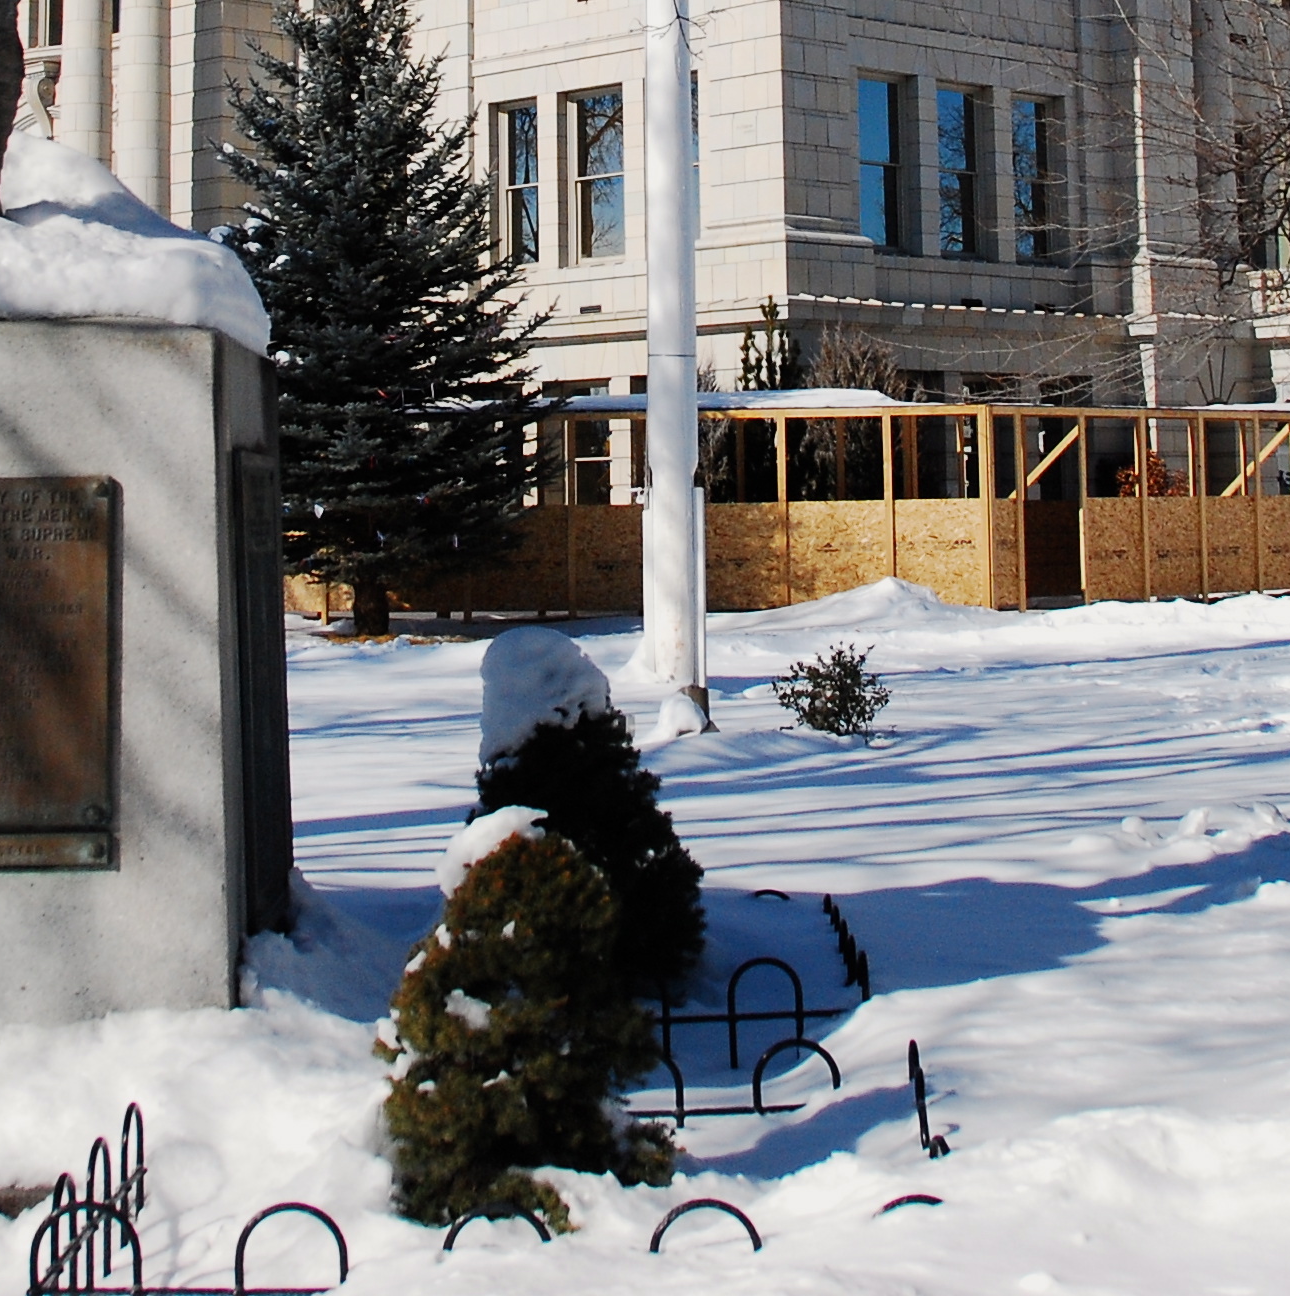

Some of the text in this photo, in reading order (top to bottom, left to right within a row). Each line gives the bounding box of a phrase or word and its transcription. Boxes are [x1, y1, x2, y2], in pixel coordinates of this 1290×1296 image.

[21, 490, 42, 504] OF
[2, 508, 32, 522] THE
[38, 508, 73, 522] MEN
[21, 527, 98, 541] SUPREME
[6, 545, 52, 561] WAR.
